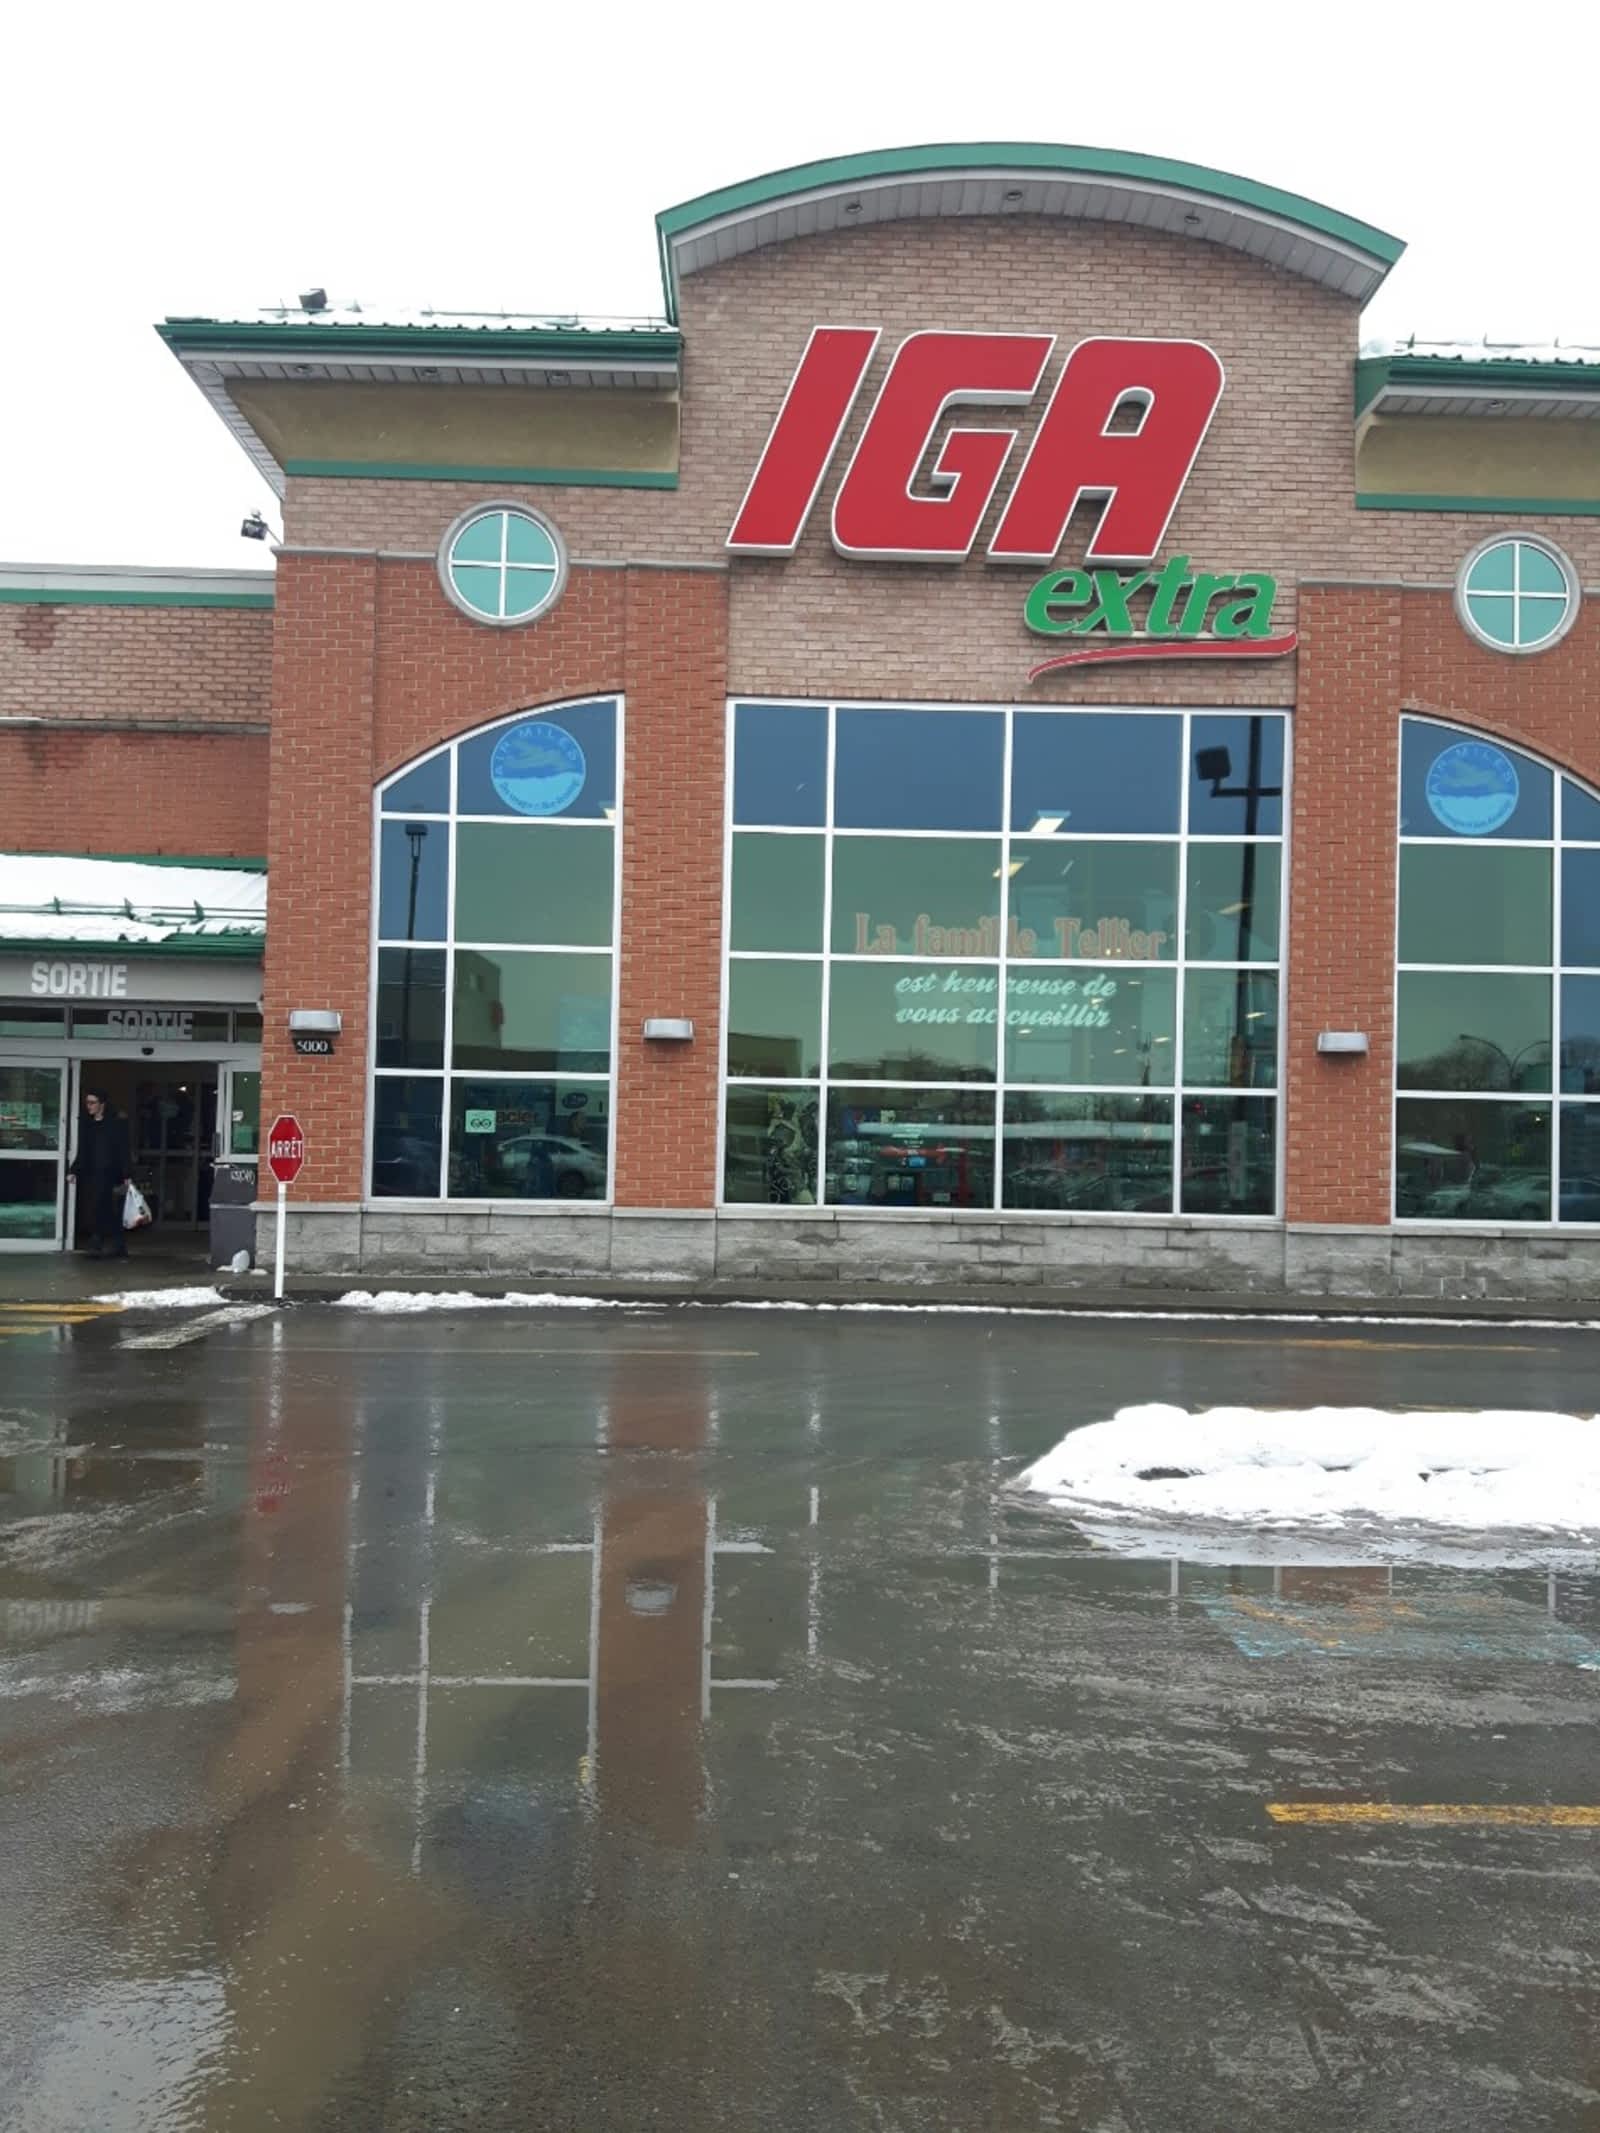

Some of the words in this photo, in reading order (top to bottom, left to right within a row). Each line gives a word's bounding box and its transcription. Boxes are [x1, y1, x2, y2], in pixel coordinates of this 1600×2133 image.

[725, 325, 1226, 568] IGA
[1023, 554, 1278, 640] extra
[855, 912, 898, 956] La
[913, 914, 1038, 958] famille
[1054, 917, 1168, 961] Tellier
[31, 961, 128, 997] SORTIE
[895, 974, 936, 993] est
[942, 970, 1077, 996] heureuse
[1083, 974, 1118, 997] de
[107, 1010, 193, 1040] SORTIE
[895, 1008, 961, 1025] vous
[966, 1003, 1112, 1028] accueillir
[271, 1137, 303, 1159] ARRÊT
